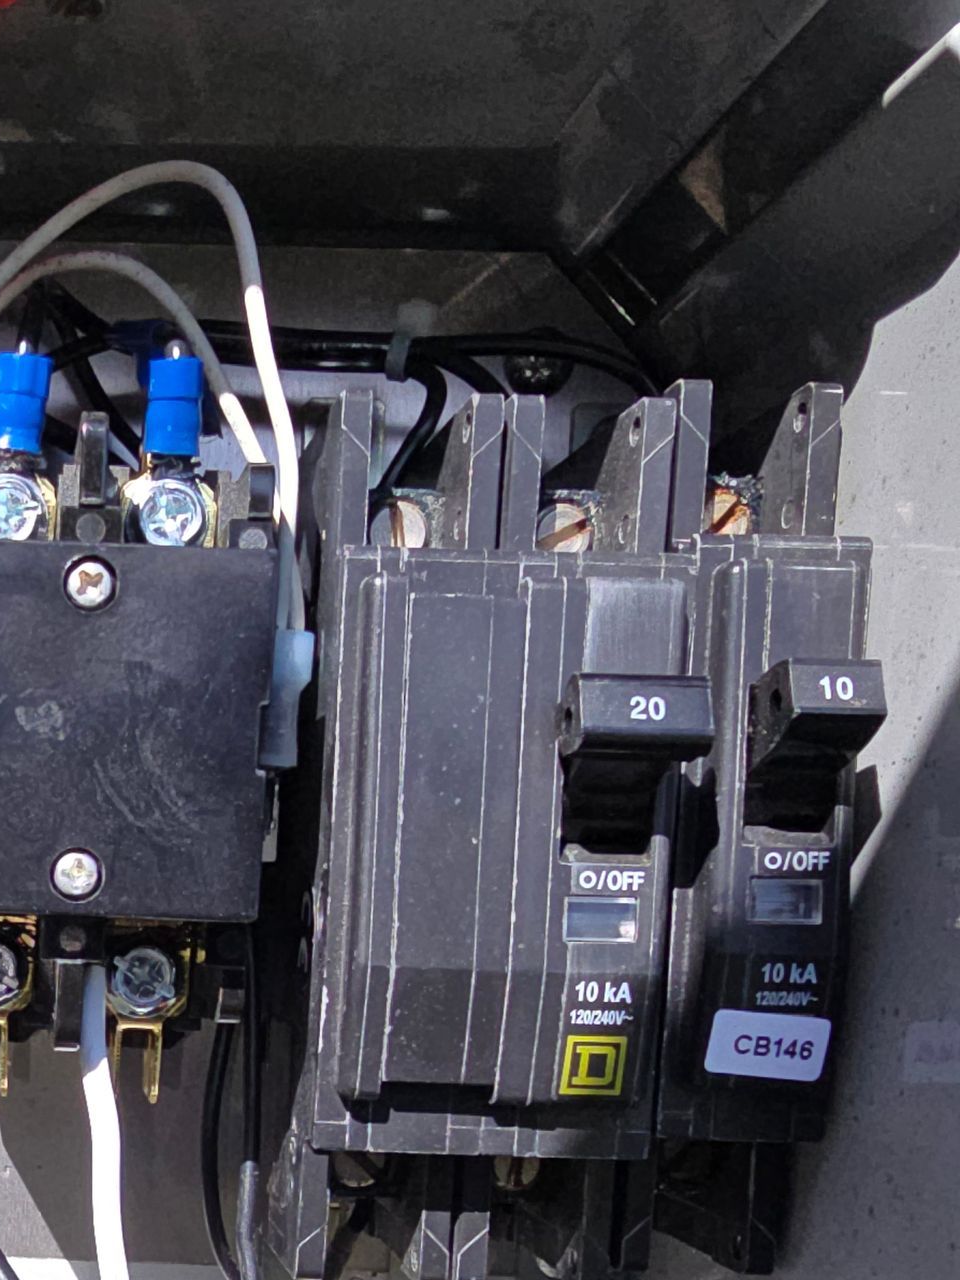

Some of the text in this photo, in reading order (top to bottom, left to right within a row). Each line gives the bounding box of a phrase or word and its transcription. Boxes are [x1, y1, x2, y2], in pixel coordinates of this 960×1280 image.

[818, 676, 854, 700] 10
[629, 697, 666, 721] 20
[761, 963, 818, 984] 10 kA
[575, 981, 632, 1004] 10 kA
[733, 1034, 815, 1060] CB146
